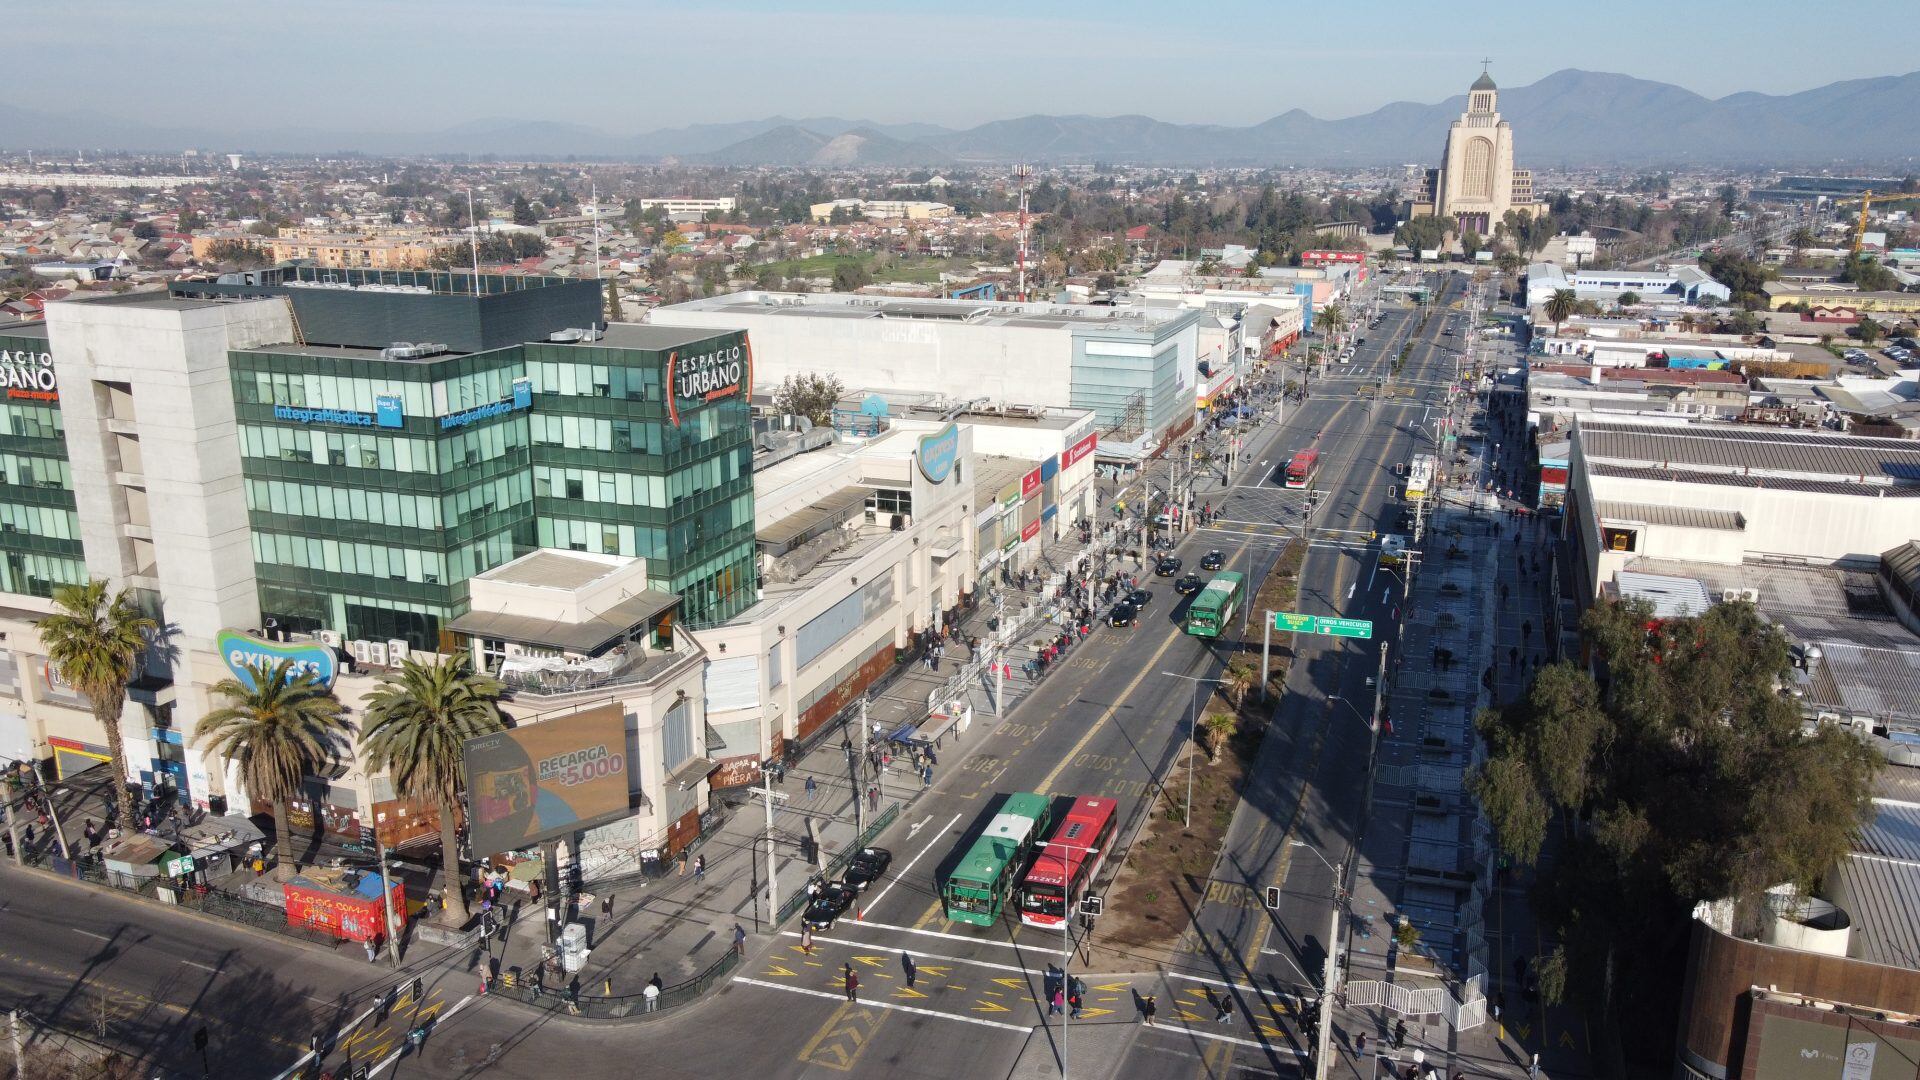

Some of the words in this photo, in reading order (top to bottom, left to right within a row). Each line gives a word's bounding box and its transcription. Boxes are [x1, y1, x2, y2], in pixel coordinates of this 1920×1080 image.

[681, 346, 739, 373] ESPACIO
[682, 361, 740, 398] URBANO
[274, 404, 372, 426] IntegraMédica
[441, 402, 512, 429] IntegraMédica
[1319, 618, 1337, 626] OTROS
[1339, 620, 1370, 628] VEHICULOS
[471, 739, 501, 752] DIRECTV
[539, 745, 607, 774] RECARGA
[560, 754, 623, 786] $5.000
